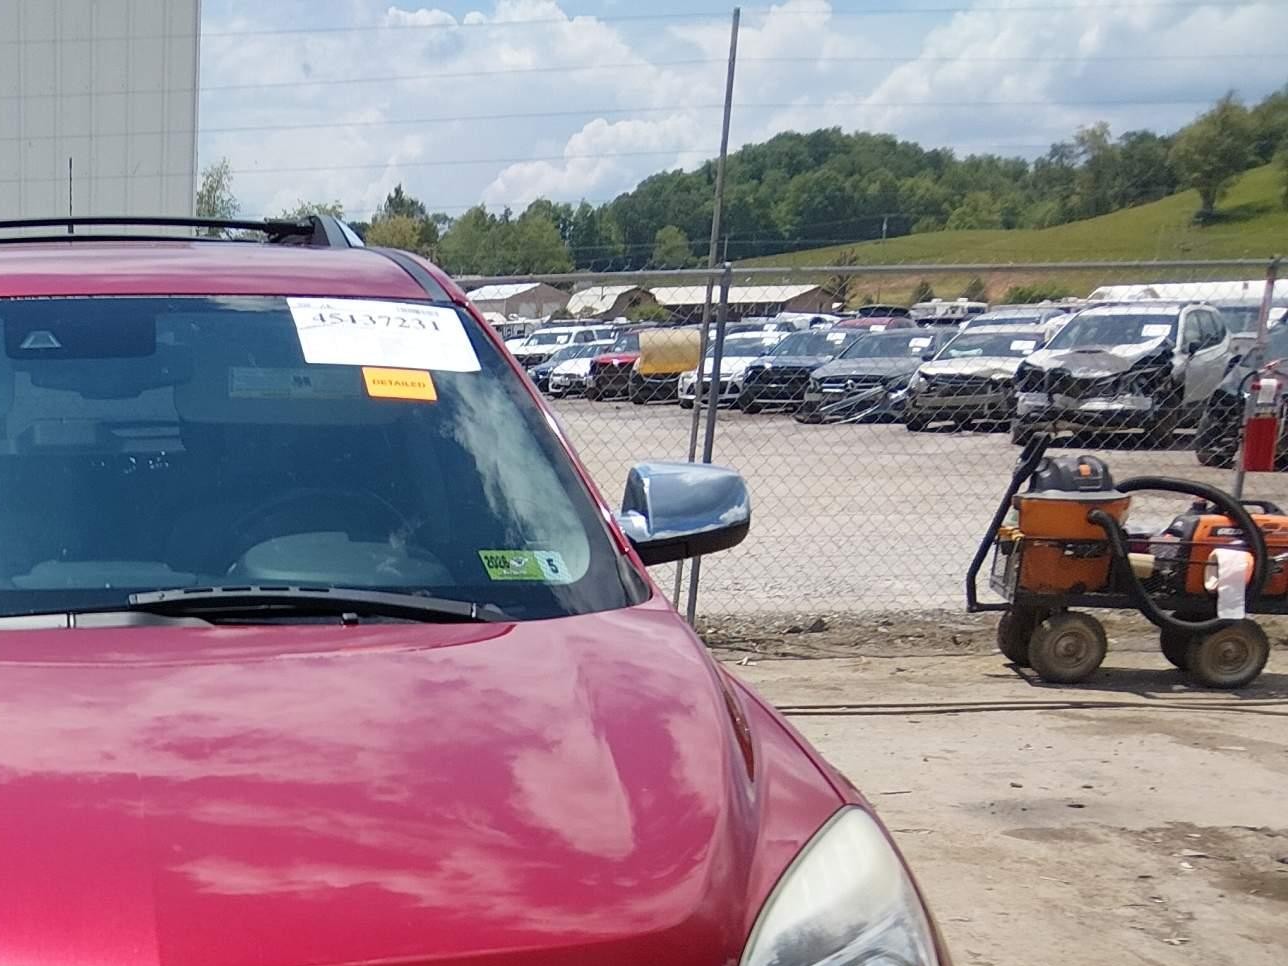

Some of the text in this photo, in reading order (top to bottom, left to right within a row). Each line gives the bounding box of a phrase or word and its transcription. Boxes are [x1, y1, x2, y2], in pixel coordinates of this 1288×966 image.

[312, 312, 441, 331] 45137231
[372, 378, 426, 389] DETAILED
[545, 557, 559, 574] 5
